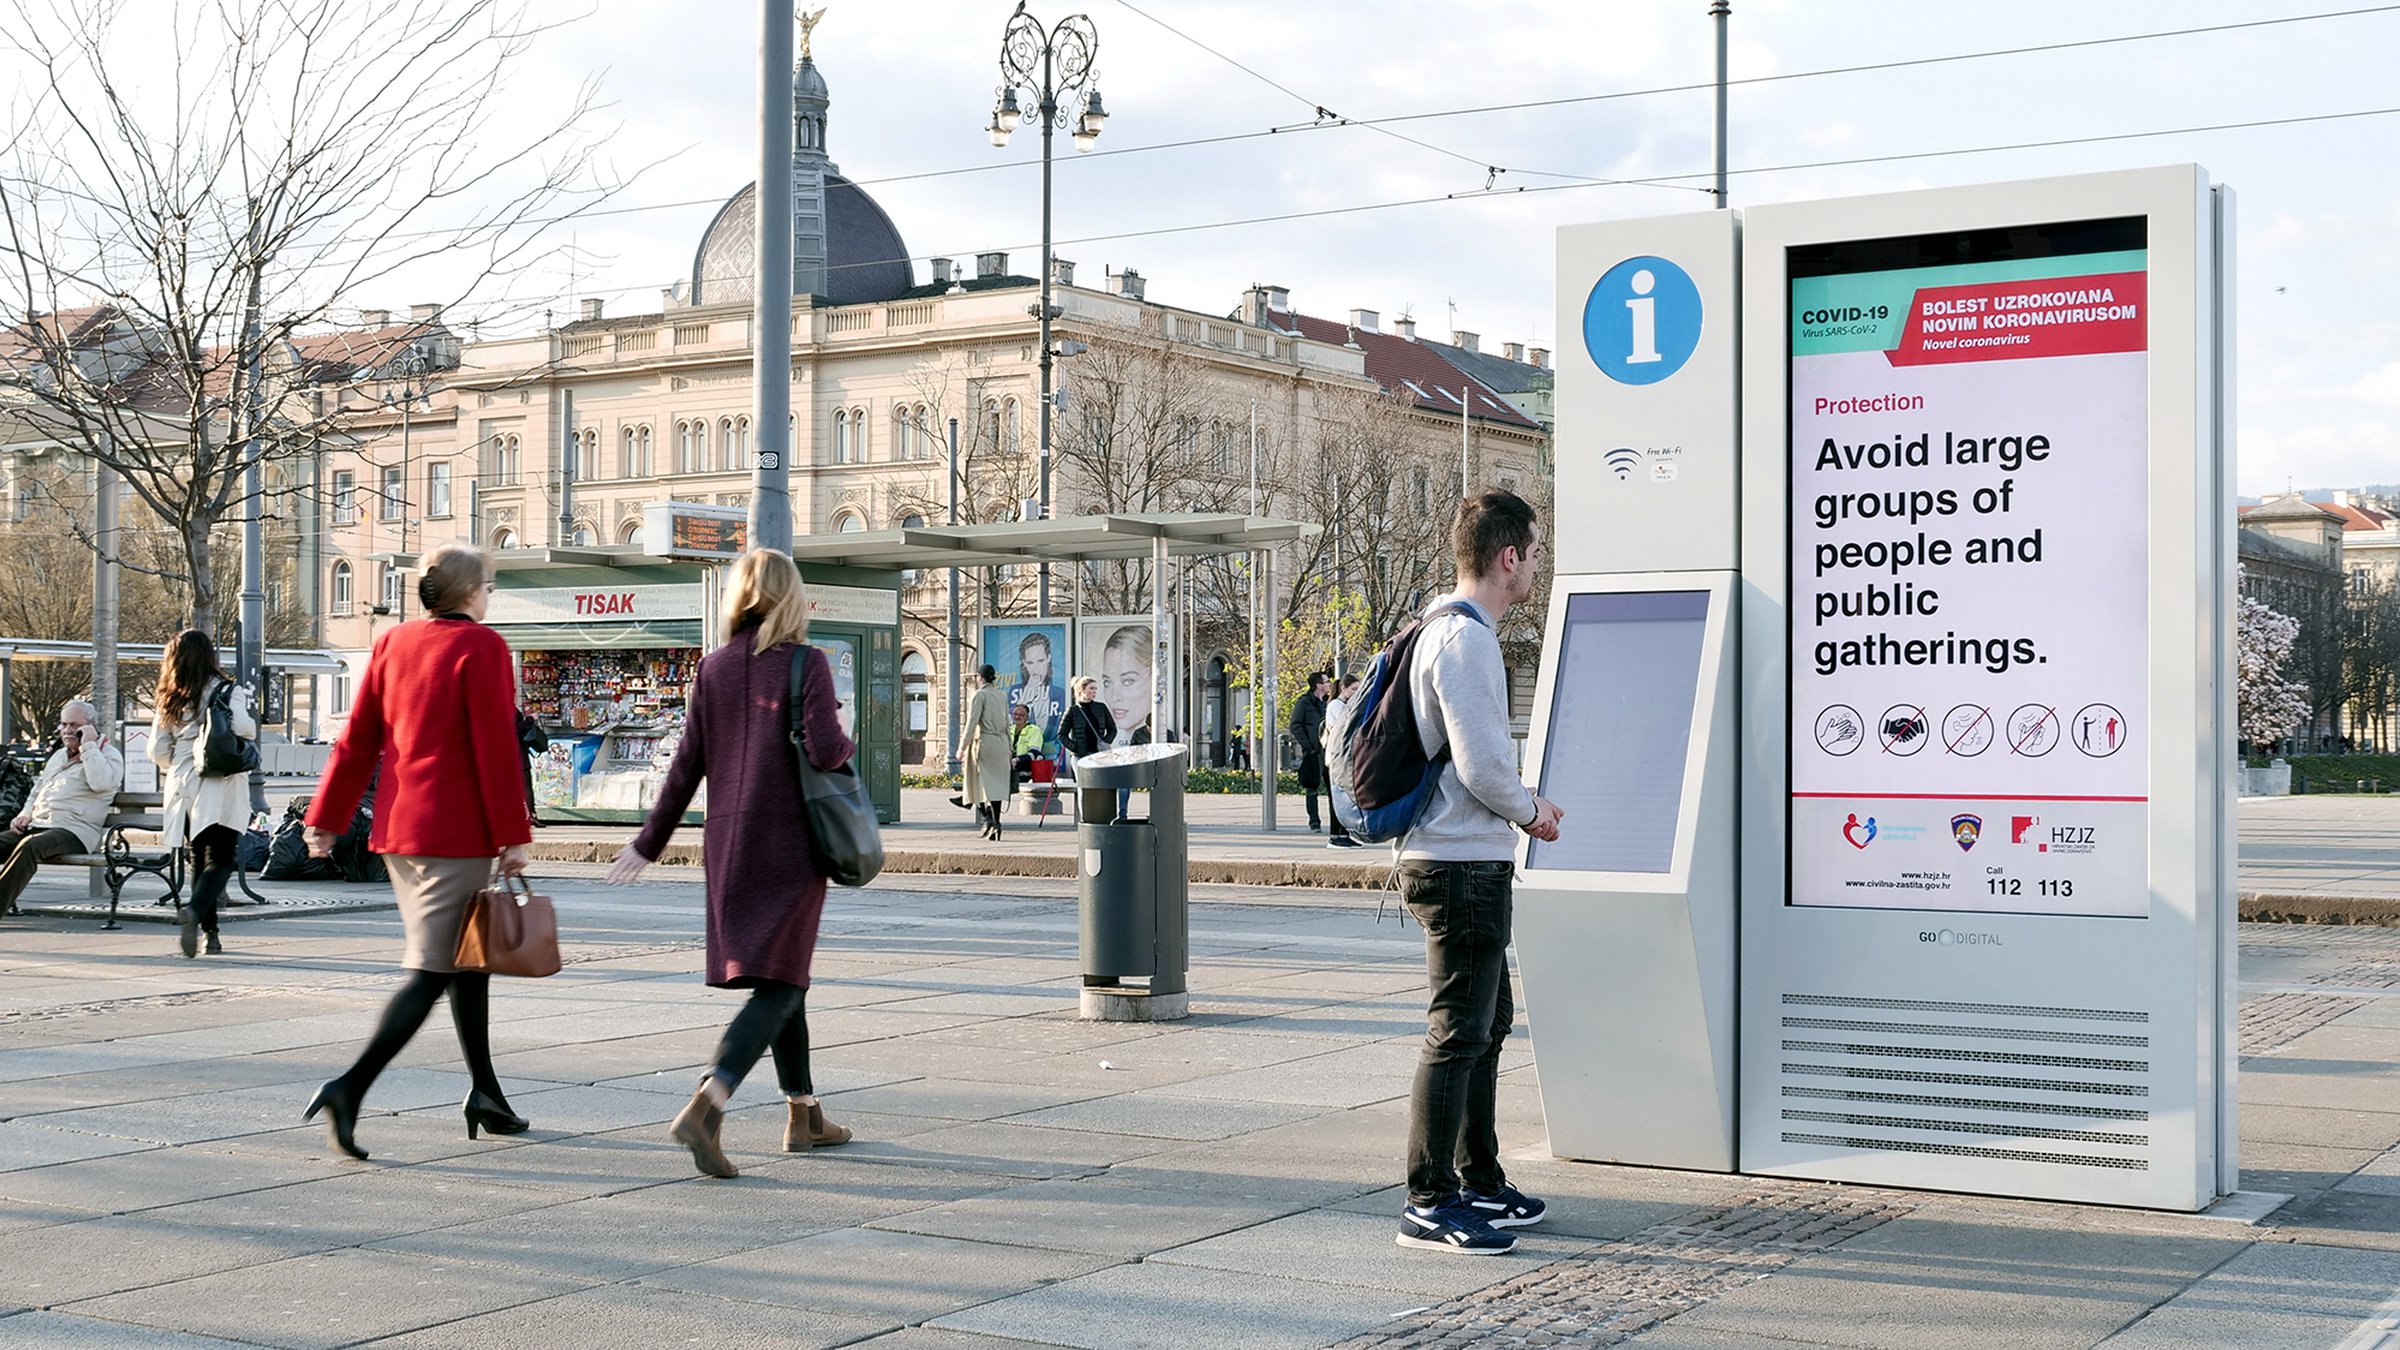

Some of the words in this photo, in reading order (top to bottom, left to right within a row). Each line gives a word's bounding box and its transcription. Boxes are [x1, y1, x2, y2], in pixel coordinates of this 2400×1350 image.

[1922, 298, 1988, 316] BOLEST
[1993, 288, 2114, 311] UZROKOVANA
[1802, 305, 1889, 325] COVID-19
[1922, 316, 1977, 333] NOVIM
[1983, 305, 2136, 330] KORONAVIRUSOM
[1802, 329, 1824, 338] Virus
[1825, 324, 1877, 337] SARS-CoV-2
[1922, 336, 1957, 350] Novel
[1958, 332, 2031, 348] coronavirus
[1815, 393, 1924, 415] Protection
[1815, 432, 1929, 471] Avoid
[1946, 432, 2051, 472] large
[1815, 488, 1958, 529] groups
[1972, 479, 2014, 514] of
[1815, 532, 1953, 577] people
[1965, 529, 2043, 565] and
[575, 594, 636, 615] TISAK
[1815, 583, 1939, 626] public
[1815, 632, 2047, 676] gatherings.
[1010, 685, 1050, 704] SVOJU
[2052, 827, 2095, 844] HZJZ
[1901, 872, 1951, 881] www.hzjz.hr
[1986, 867, 2003, 875] Call
[1845, 880, 1951, 891] www.civilna-zastita.gov.hr
[1987, 879, 2021, 896] 112
[2038, 879, 2073, 897] 113
